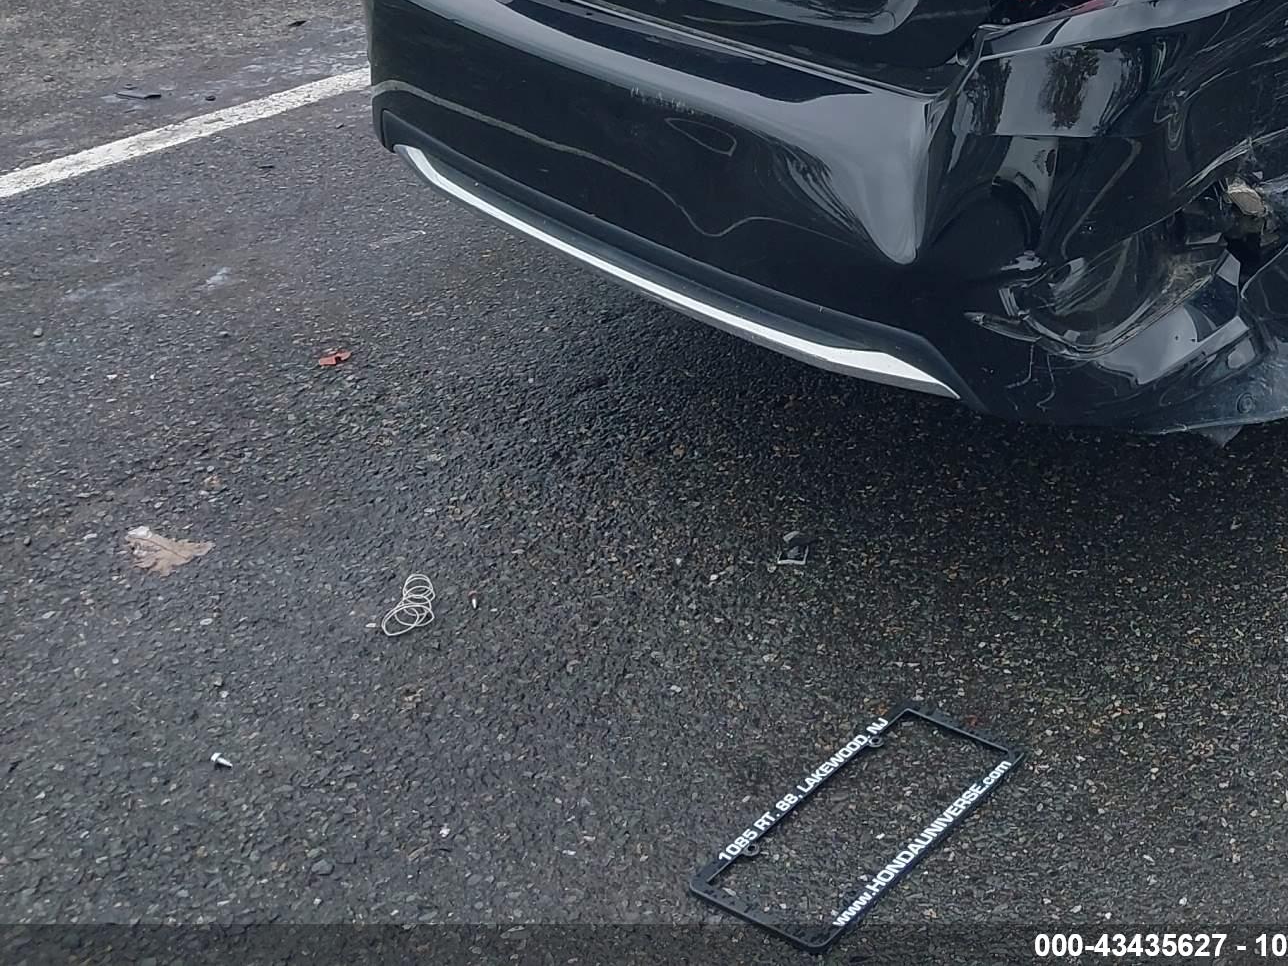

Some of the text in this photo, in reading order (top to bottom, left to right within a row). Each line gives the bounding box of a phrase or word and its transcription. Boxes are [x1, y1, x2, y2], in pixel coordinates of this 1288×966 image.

[718, 828, 758, 861] 1085
[753, 812, 781, 833] RT.
[866, 717, 889, 736] NJ
[832, 760, 1012, 927] www.HONDAUNIVERSE.com
